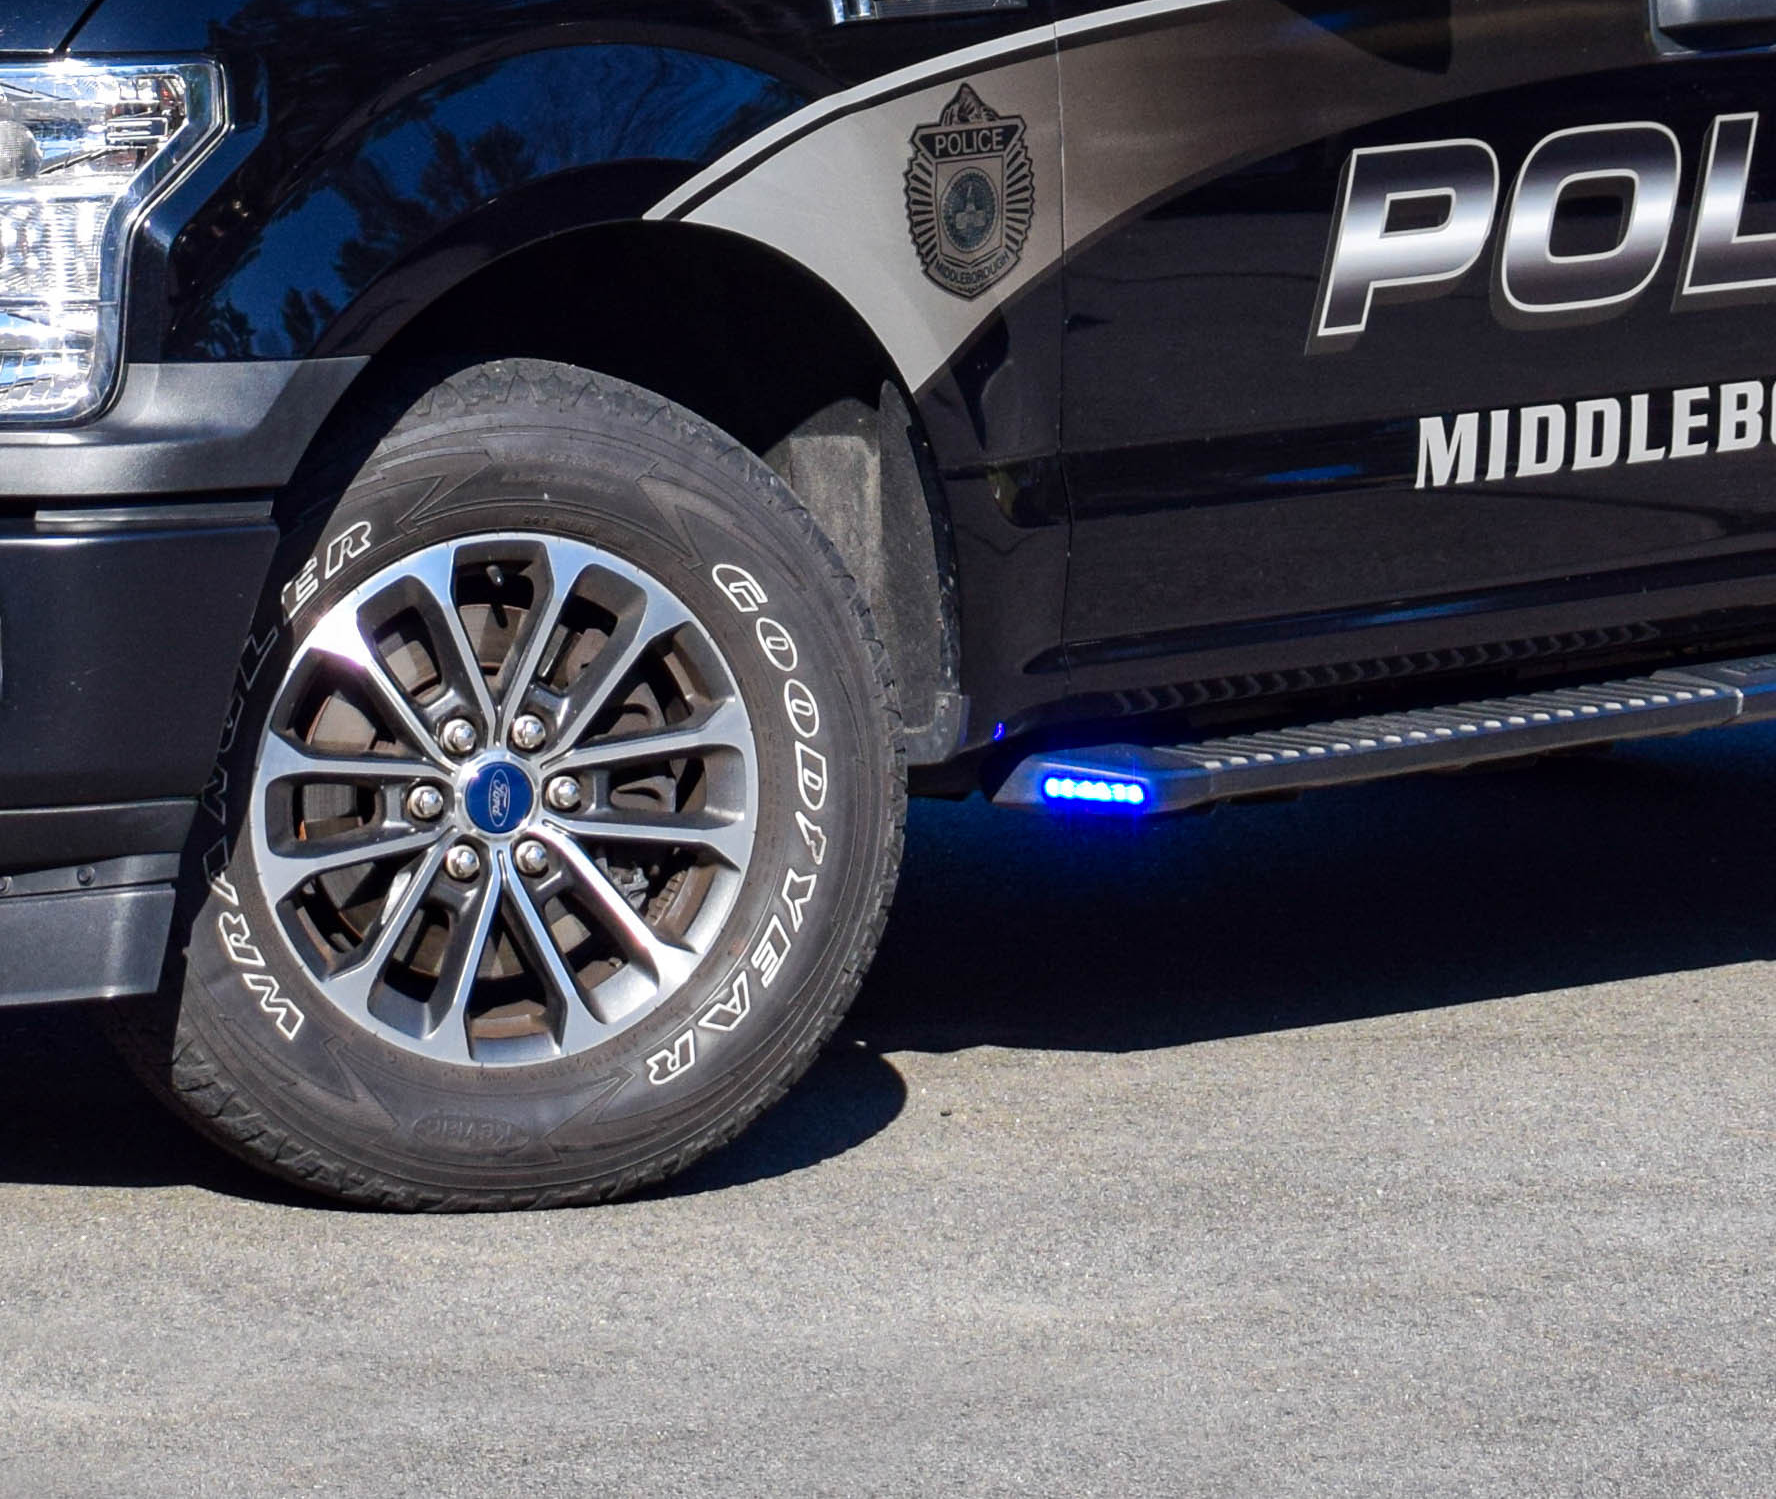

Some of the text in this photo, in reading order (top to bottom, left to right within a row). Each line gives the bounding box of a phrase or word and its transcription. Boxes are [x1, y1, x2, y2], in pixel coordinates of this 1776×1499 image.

[935, 128, 1004, 156] POLICE
[935, 251, 1010, 283] MIDDLEBOROUGH
[492, 779, 508, 817] Ford
[646, 563, 827, 1085] GOODYEAR
